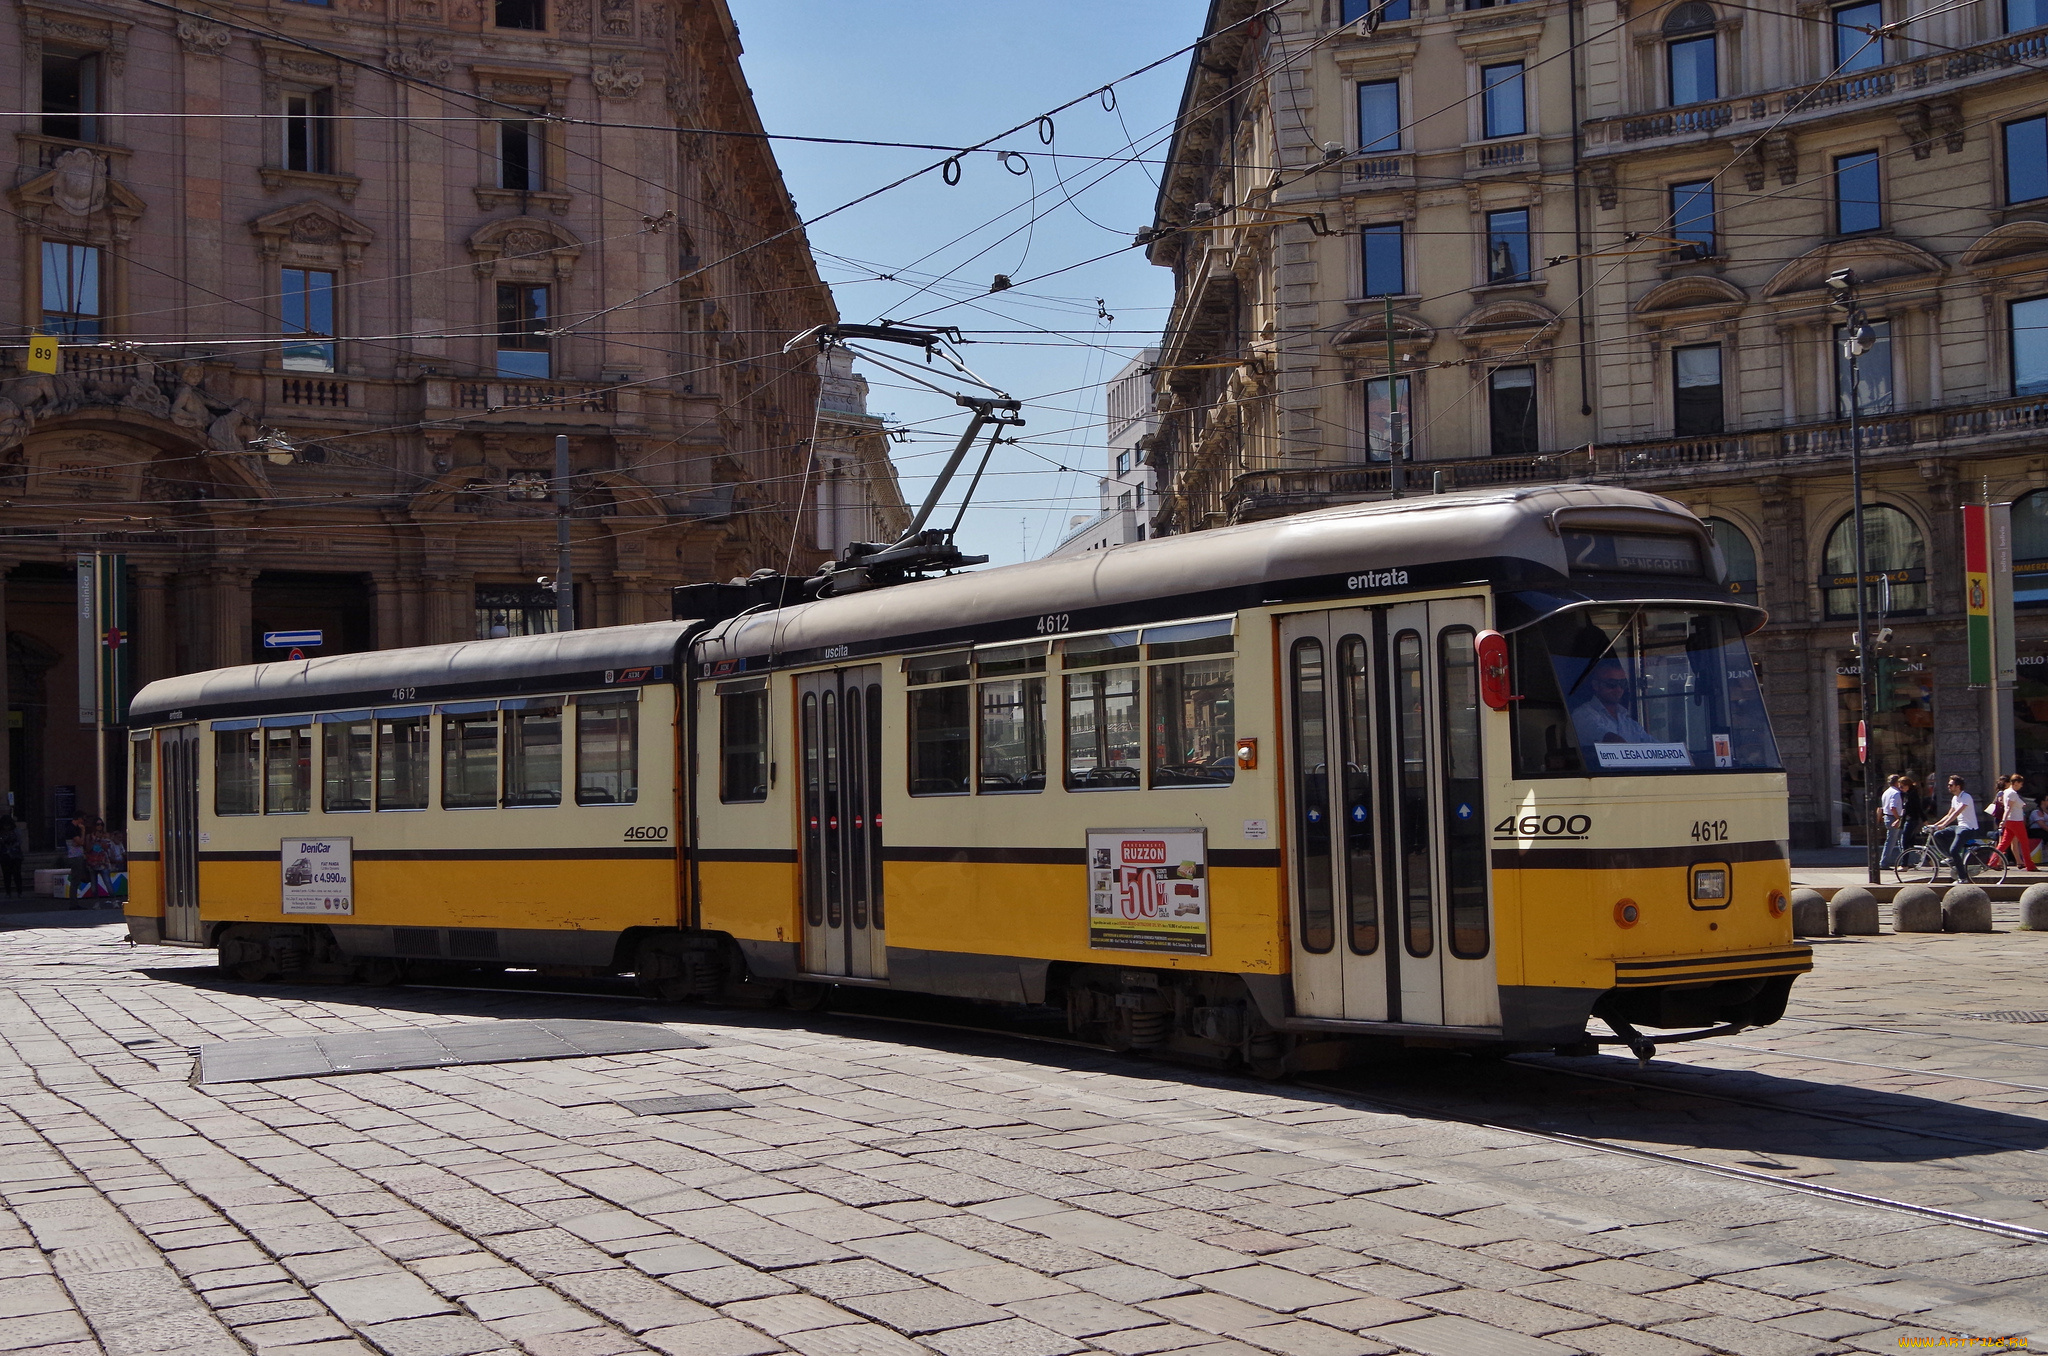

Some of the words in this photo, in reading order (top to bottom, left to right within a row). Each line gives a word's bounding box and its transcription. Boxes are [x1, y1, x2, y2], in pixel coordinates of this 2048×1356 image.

[35, 347, 52, 360] 89
[59, 463, 114, 480] POSTE
[1573, 533, 1599, 568] 2
[1347, 568, 1409, 590] entrata
[81, 575, 90, 619] dominica
[1036, 613, 1069, 634] 4612
[825, 645, 849, 659] uscita
[2016, 655, 2044, 665] ARLO
[392, 687, 416, 700] 4612
[1600, 750, 1618, 760] term.
[1620, 749, 1642, 760] LEGA
[1642, 749, 1686, 760] LOMBARDA
[1719, 742, 1725, 755] 7
[1494, 814, 1592, 836] 4600
[1691, 820, 1728, 842] 4612
[624, 826, 669, 839] 4600
[301, 842, 331, 853] DeniCar
[1123, 848, 1164, 860] RUZZON
[314, 874, 318, 883] €
[320, 872, 346, 884] 4.990,00
[1120, 865, 1169, 920] 50%
